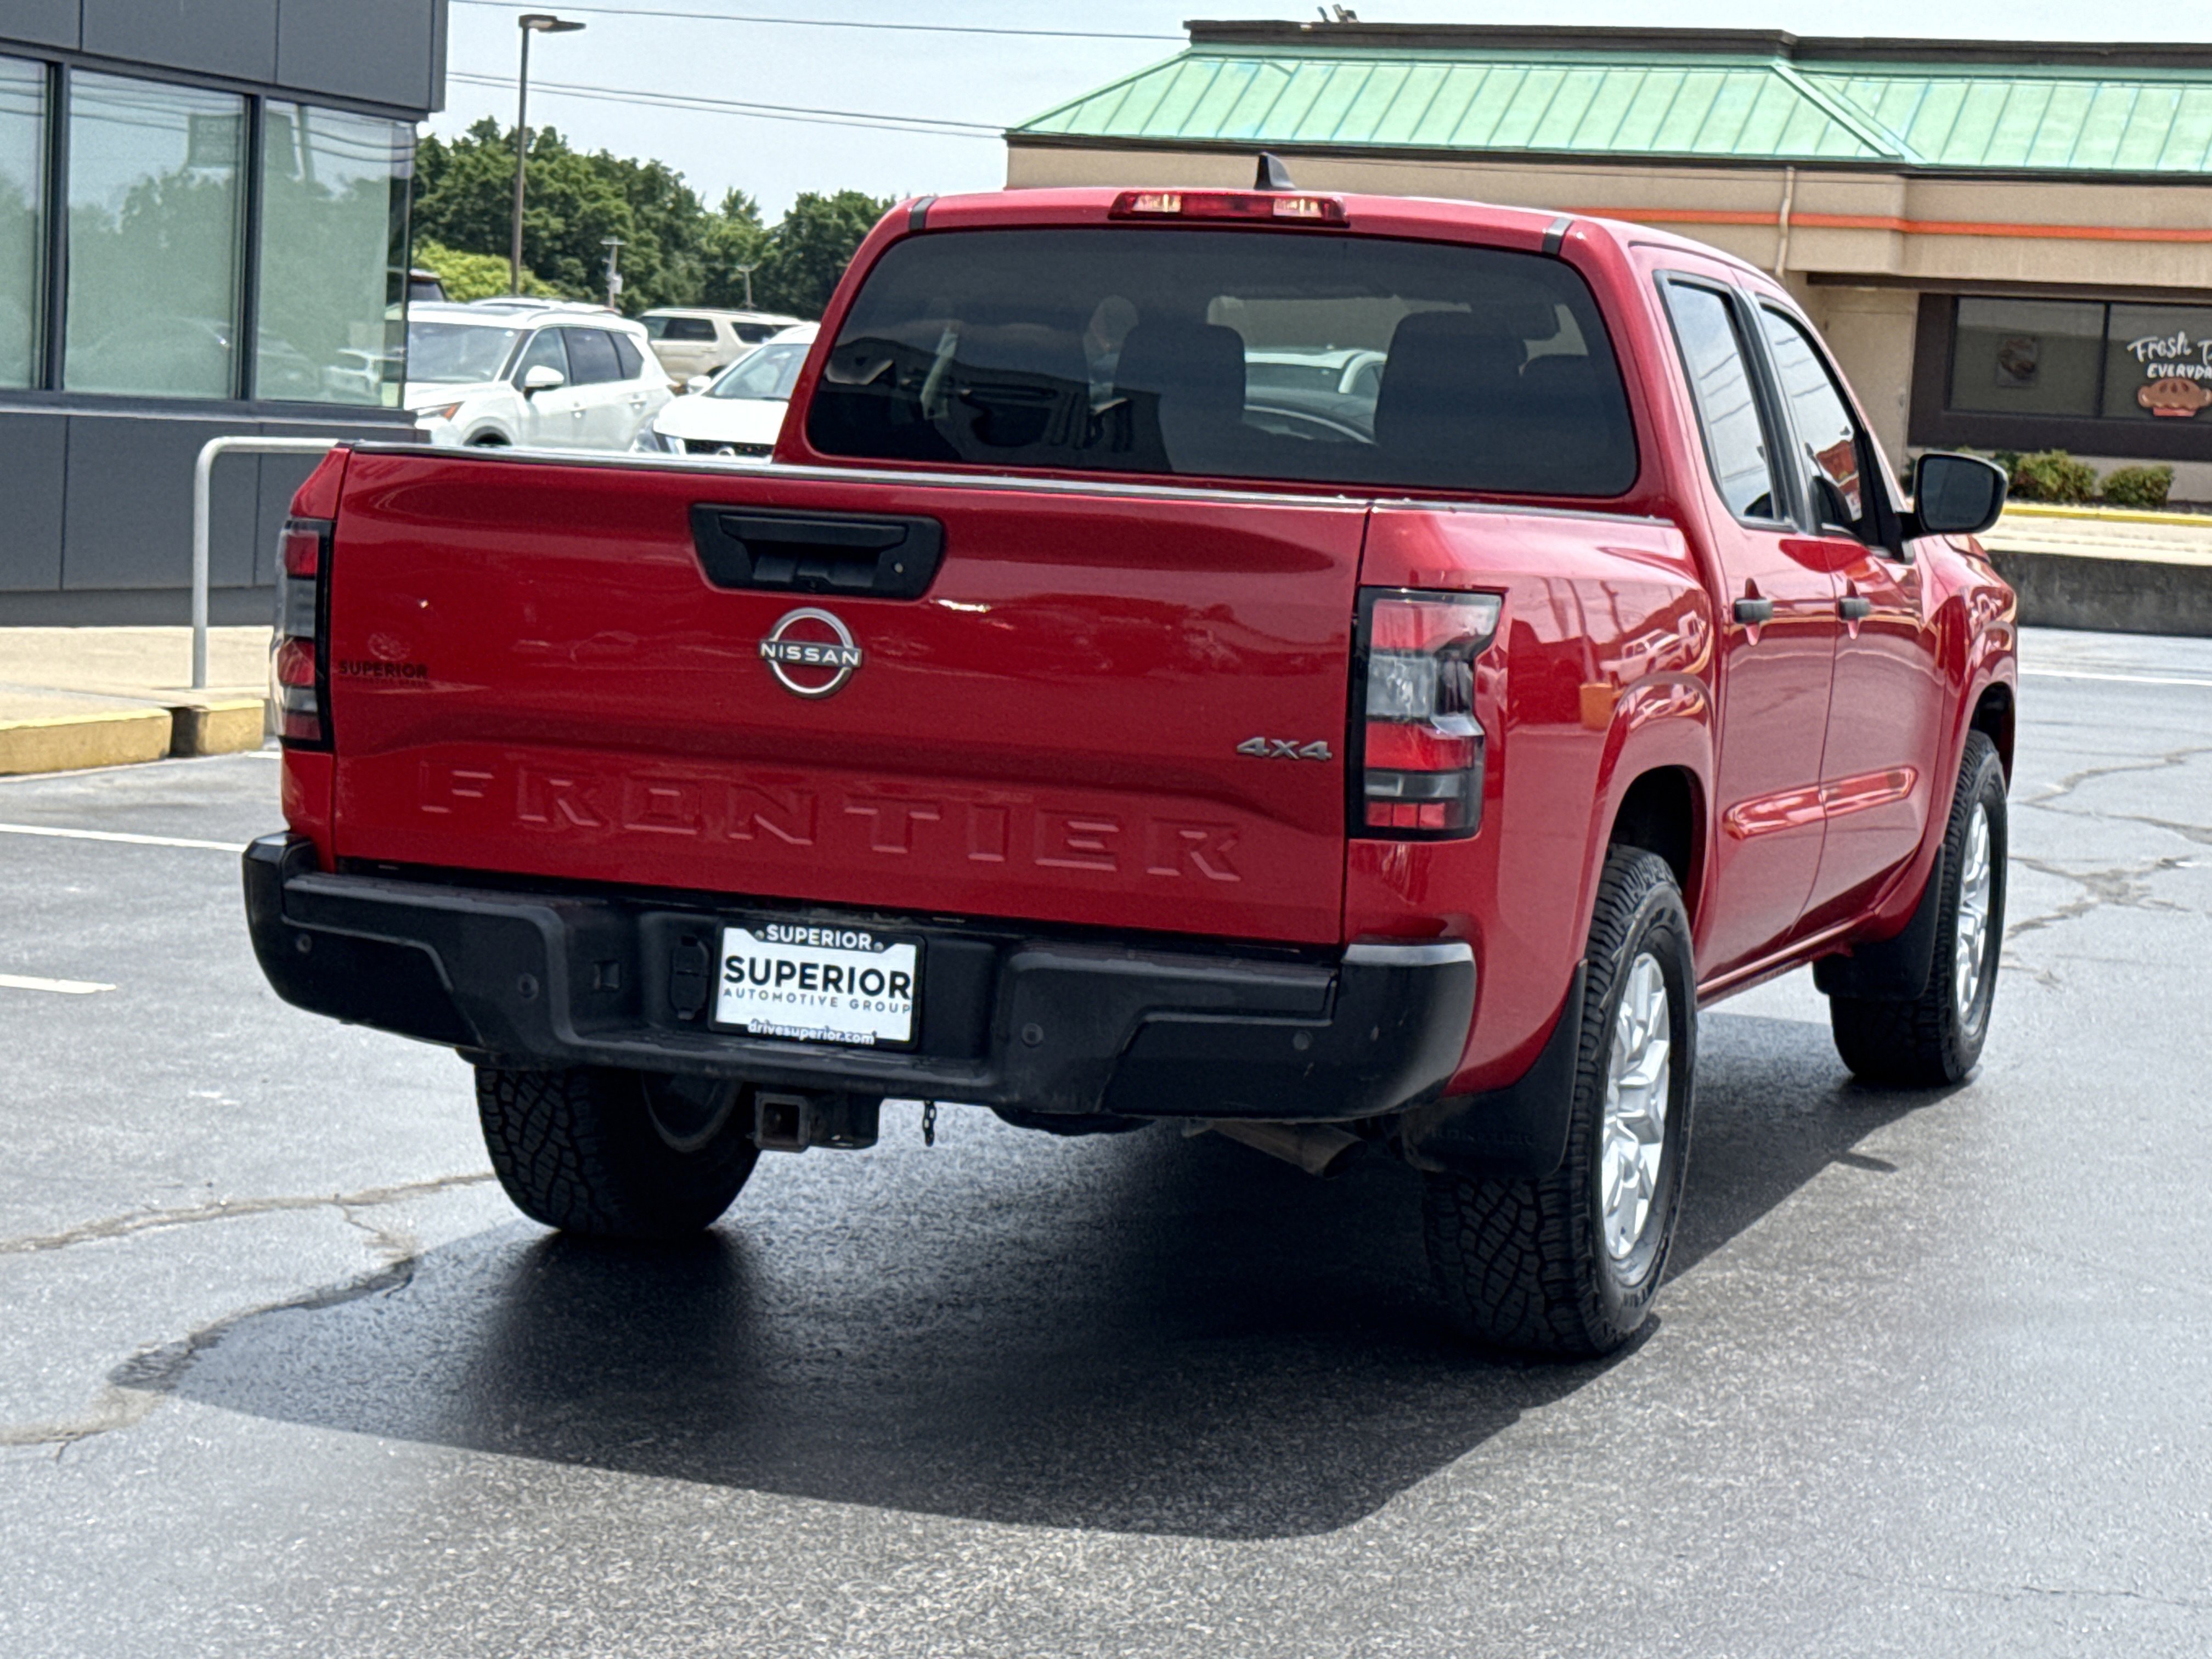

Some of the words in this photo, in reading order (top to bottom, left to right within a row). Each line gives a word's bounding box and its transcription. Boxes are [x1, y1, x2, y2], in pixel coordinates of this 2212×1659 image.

[2126, 330, 2193, 363] Fresh
[760, 642, 860, 666] NISSAN
[338, 659, 428, 679] SUPERIOR
[419, 759, 1242, 882] FRONTIER
[766, 924, 872, 951] SUPERIOR
[723, 955, 911, 1000] SUPERIOR
[723, 988, 839, 1008] AUTOMOTIVE
[849, 1001, 911, 1014] GROUP
[747, 1019, 876, 1046] drivesuperior.com
